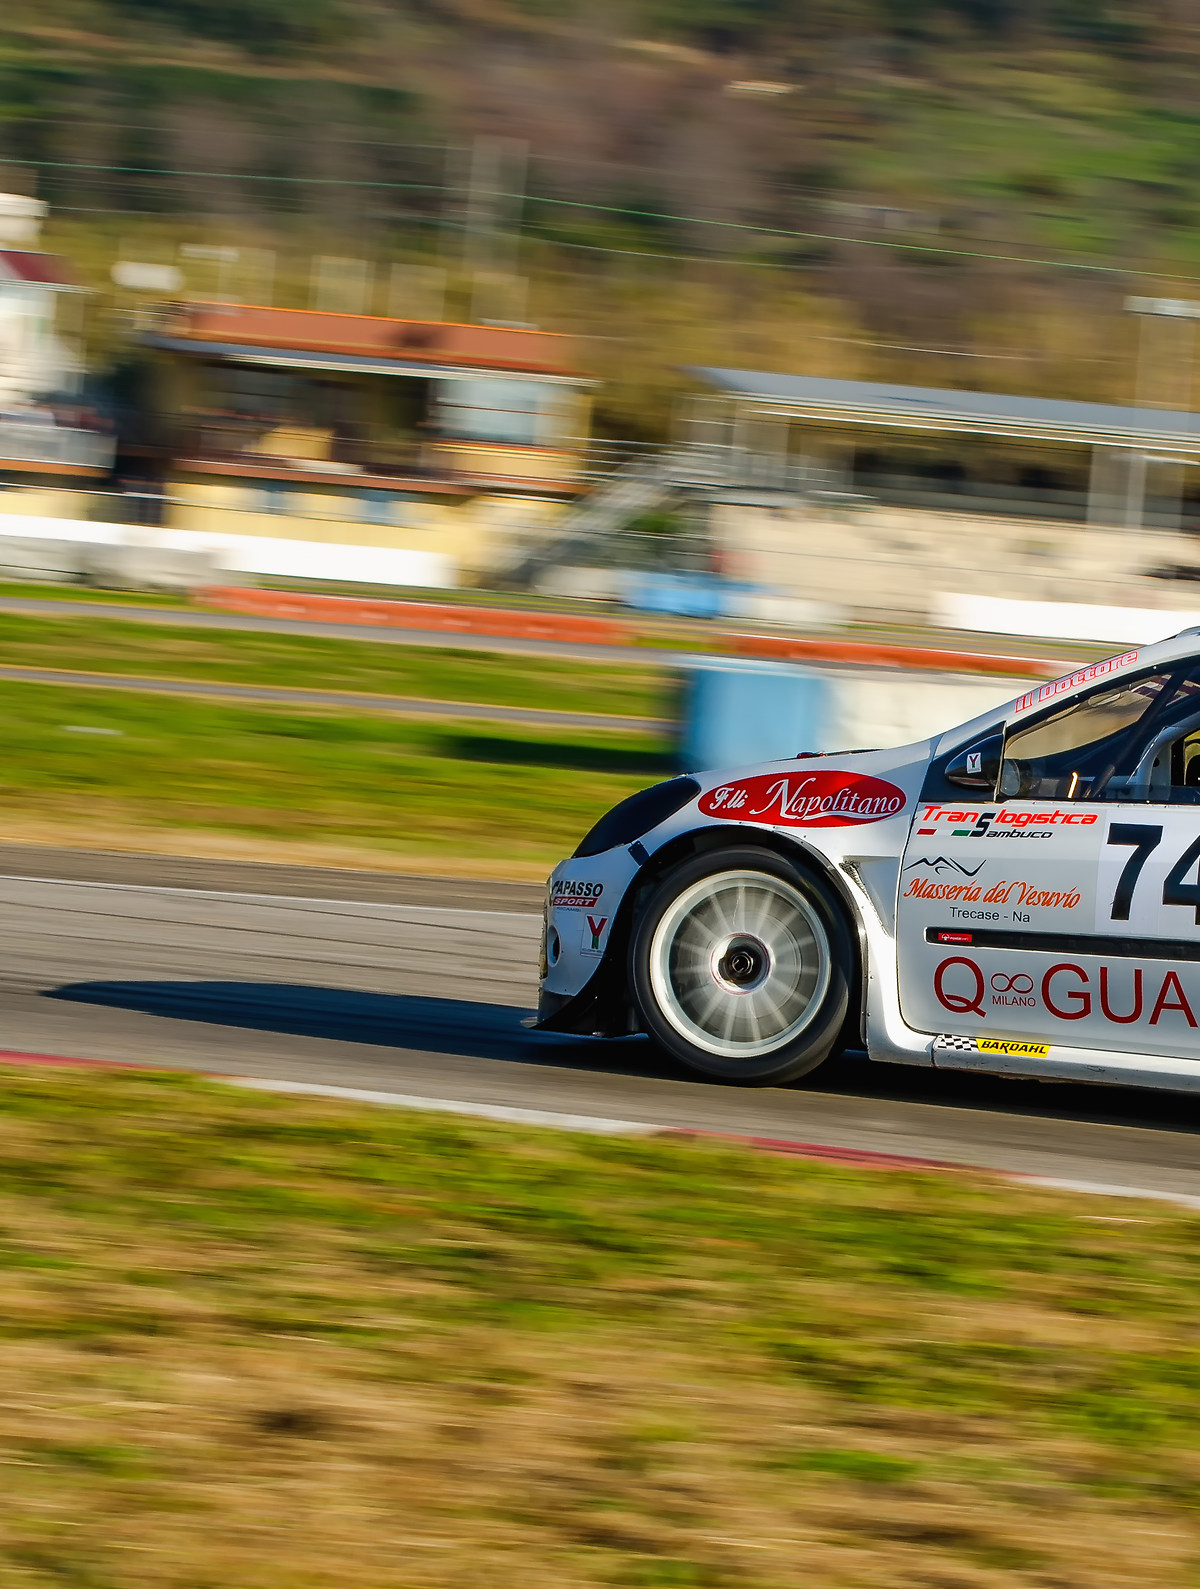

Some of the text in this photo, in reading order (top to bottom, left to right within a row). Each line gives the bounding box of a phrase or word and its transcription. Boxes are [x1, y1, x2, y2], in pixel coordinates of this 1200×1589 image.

[1039, 651, 1138, 703] Dottore
[709, 778, 901, 821] F.lli Napolitano
[554, 897, 594, 906] SPORT
[903, 878, 1082, 910] Masseria del Vesuvio
[949, 907, 1000, 921] Trecase
[1012, 911, 1031, 923] Na
[991, 994, 1037, 1008] MILANO
[980, 1039, 1048, 1056] BARDAHL
